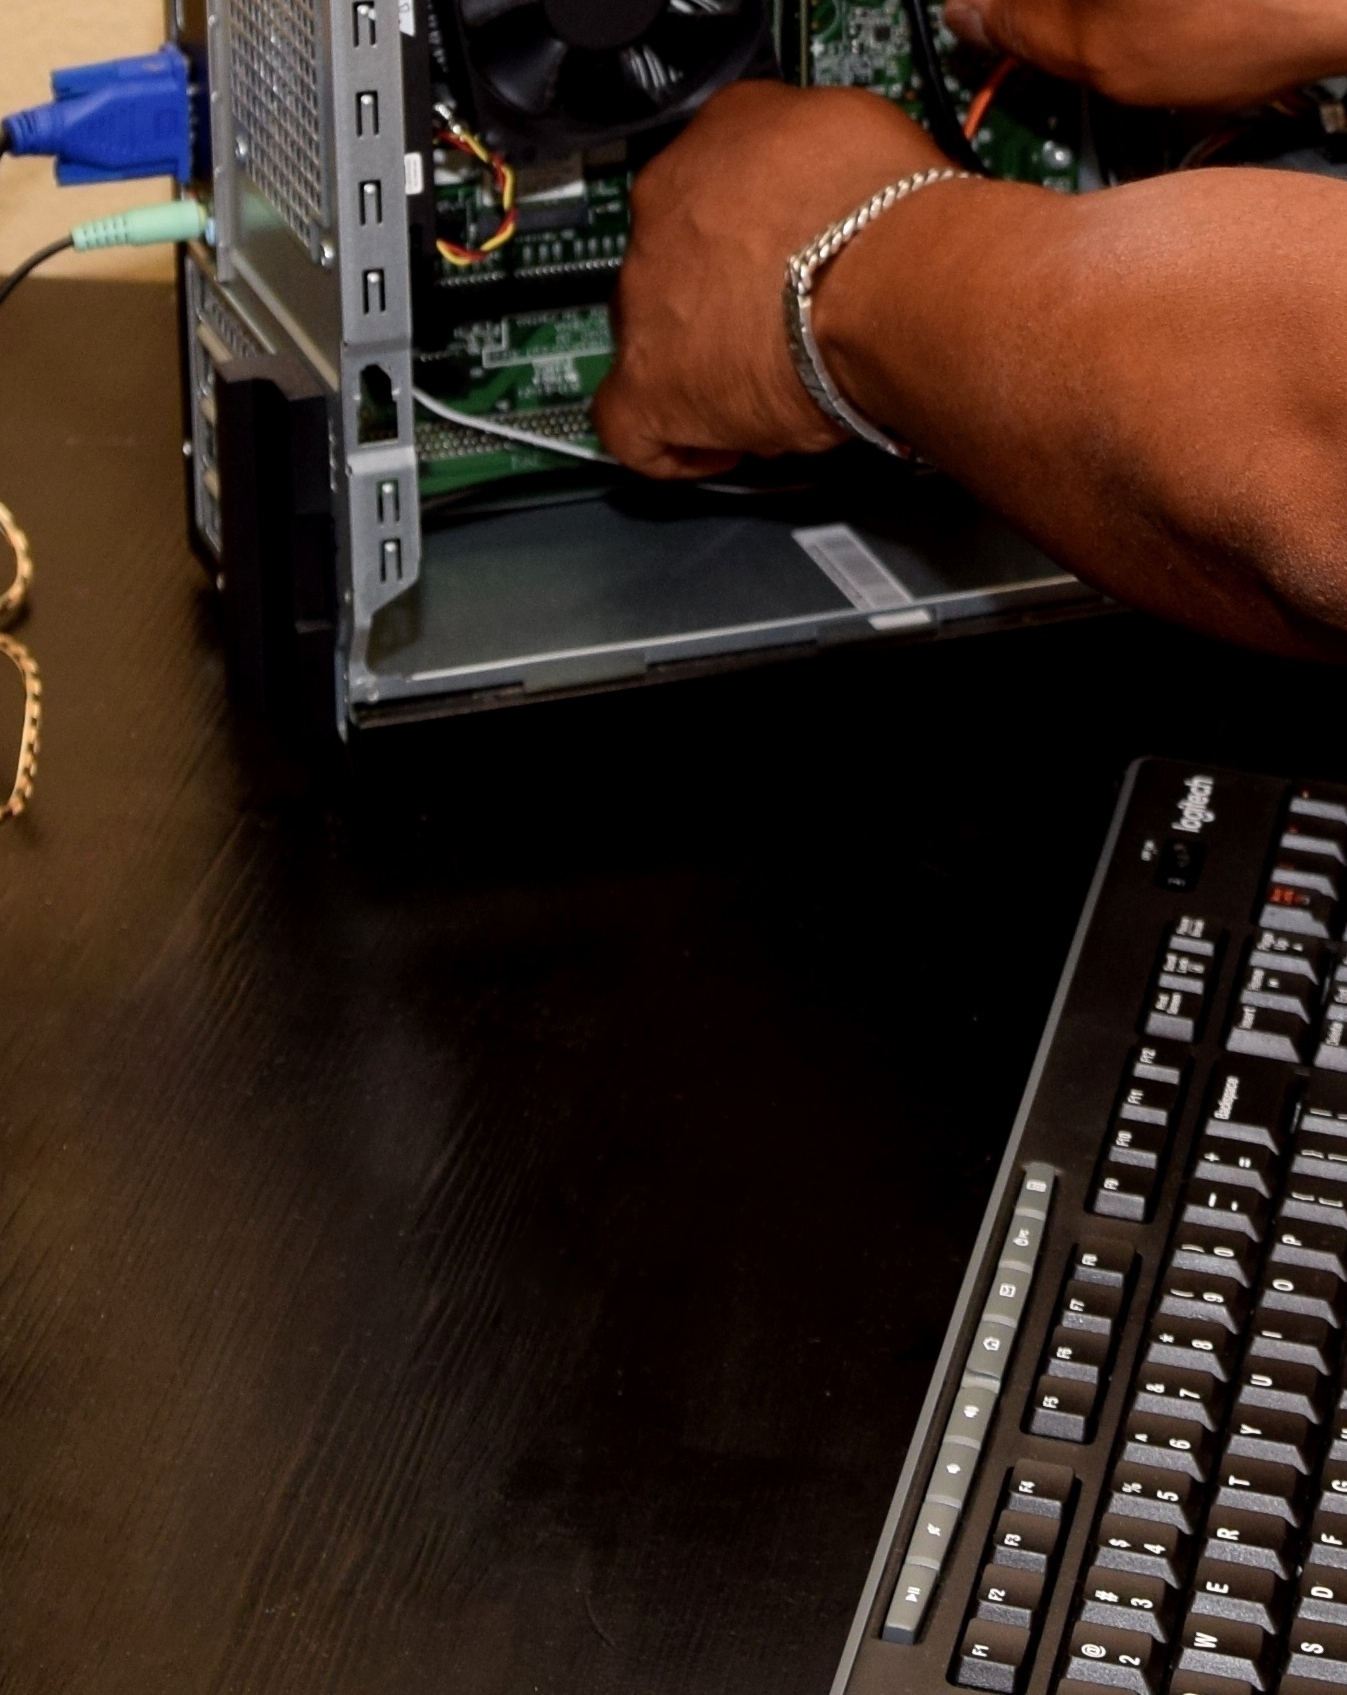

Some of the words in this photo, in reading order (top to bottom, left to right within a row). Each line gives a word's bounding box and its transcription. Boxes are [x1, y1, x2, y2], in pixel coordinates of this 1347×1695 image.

[1172, 776, 1214, 833] logitech
[1140, 1048, 1155, 1064] F12
[1127, 1089, 1143, 1105] F11
[1214, 1076, 1239, 1119] Backspace
[1116, 1131, 1131, 1147] F10
[1104, 1178, 1119, 1190] F9
[1282, 1235, 1301, 1245] P
[1214, 1247, 1234, 1257] 0
[1082, 1254, 1097, 1266] F8
[1273, 1280, 1293, 1291] O
[1203, 1293, 1223, 1302] 9
[1070, 1299, 1084, 1311] F7
[1192, 1340, 1213, 1350] 8
[1057, 1347, 1072, 1359] F6
[1251, 1374, 1272, 1386] U
[1180, 1389, 1200, 1398] 7
[1043, 1396, 1058, 1408] F5
[1241, 1424, 1261, 1434] Y
[1169, 1439, 1190, 1449] 6
[1229, 1475, 1250, 1486] T
[1019, 1481, 1034, 1493] F4
[1122, 1483, 1142, 1493] %
[1157, 1490, 1178, 1501] 5
[1004, 1534, 1021, 1546] F3
[1217, 1528, 1239, 1540] R
[1321, 1533, 1342, 1545] F
[1109, 1539, 1130, 1547] $
[1144, 1544, 1165, 1554] 4
[1206, 1582, 1229, 1593] E
[1311, 1586, 1333, 1598] D
[988, 1588, 1005, 1601] F2
[1095, 1590, 1118, 1602] #
[1131, 1598, 1153, 1608] 3
[1194, 1632, 1217, 1648] W
[972, 1644, 989, 1657] F1
[1083, 1644, 1106, 1657] @
[1301, 1642, 1324, 1654] S
[1119, 1655, 1140, 1665] 2
